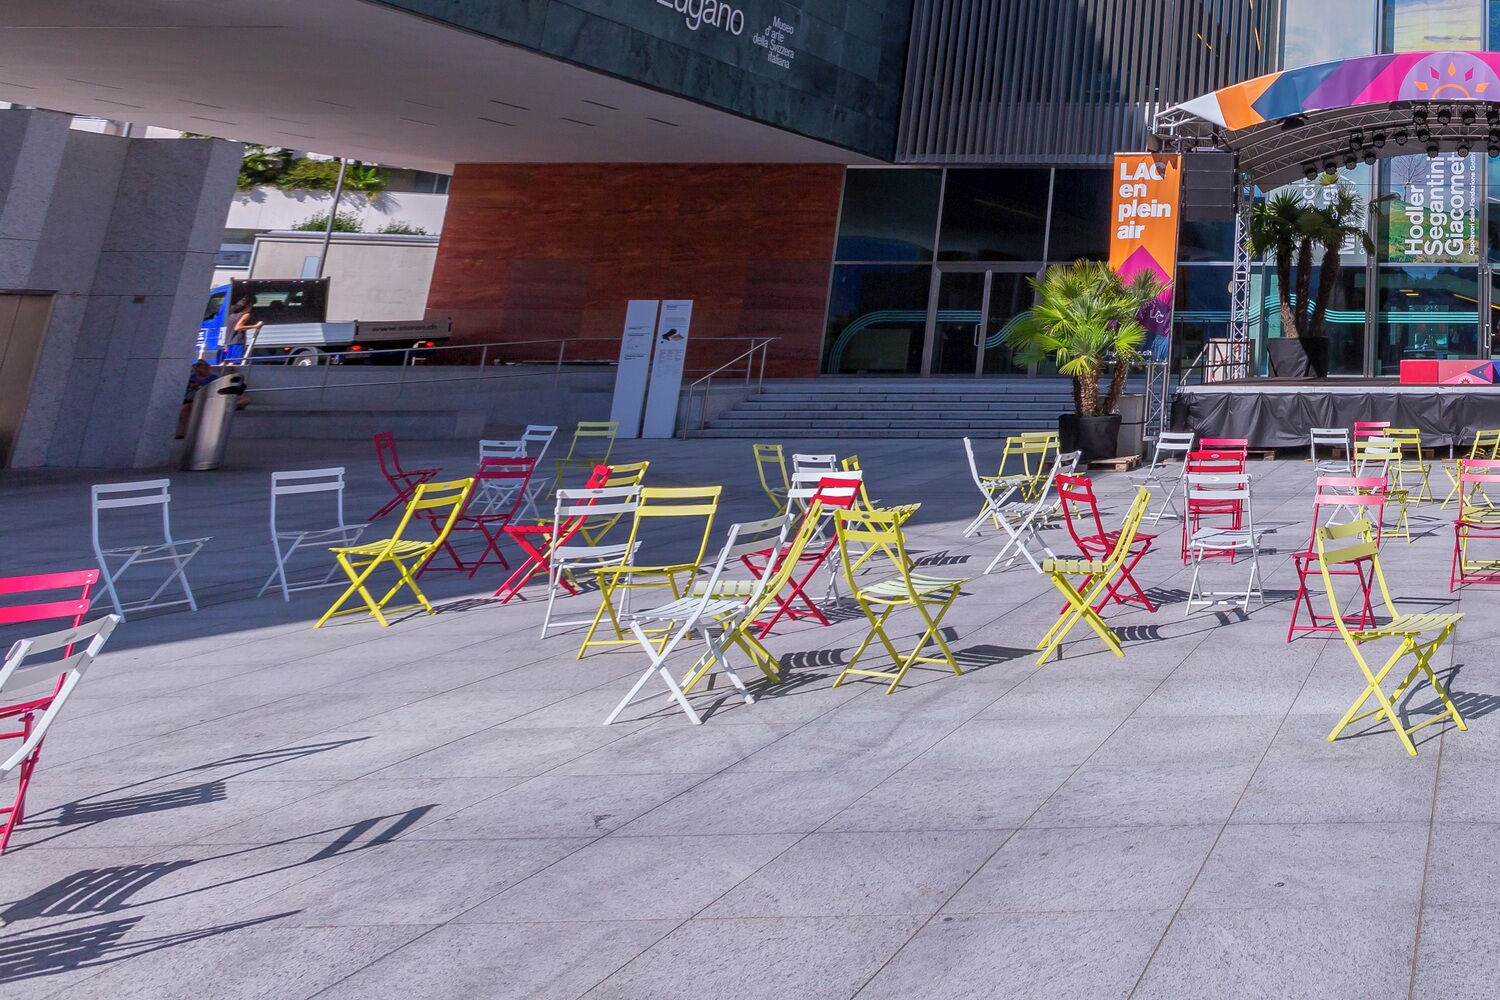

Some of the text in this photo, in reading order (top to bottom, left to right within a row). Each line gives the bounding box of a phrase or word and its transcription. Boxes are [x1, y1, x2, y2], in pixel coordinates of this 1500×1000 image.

[772, 15, 794, 35] Museo
[752, 32, 795, 59] della Svizzera
[767, 50, 791, 69] italiana
[1119, 162, 1167, 182] LAC
[1119, 183, 1147, 198] en
[1118, 200, 1171, 222] plein
[1423, 152, 1448, 256] Segantini
[1444, 152, 1465, 256] Giacomet
[1116, 221, 1145, 240] air
[1404, 185, 1425, 255] Hodler
[1468, 223, 1476, 256] Capolavori
